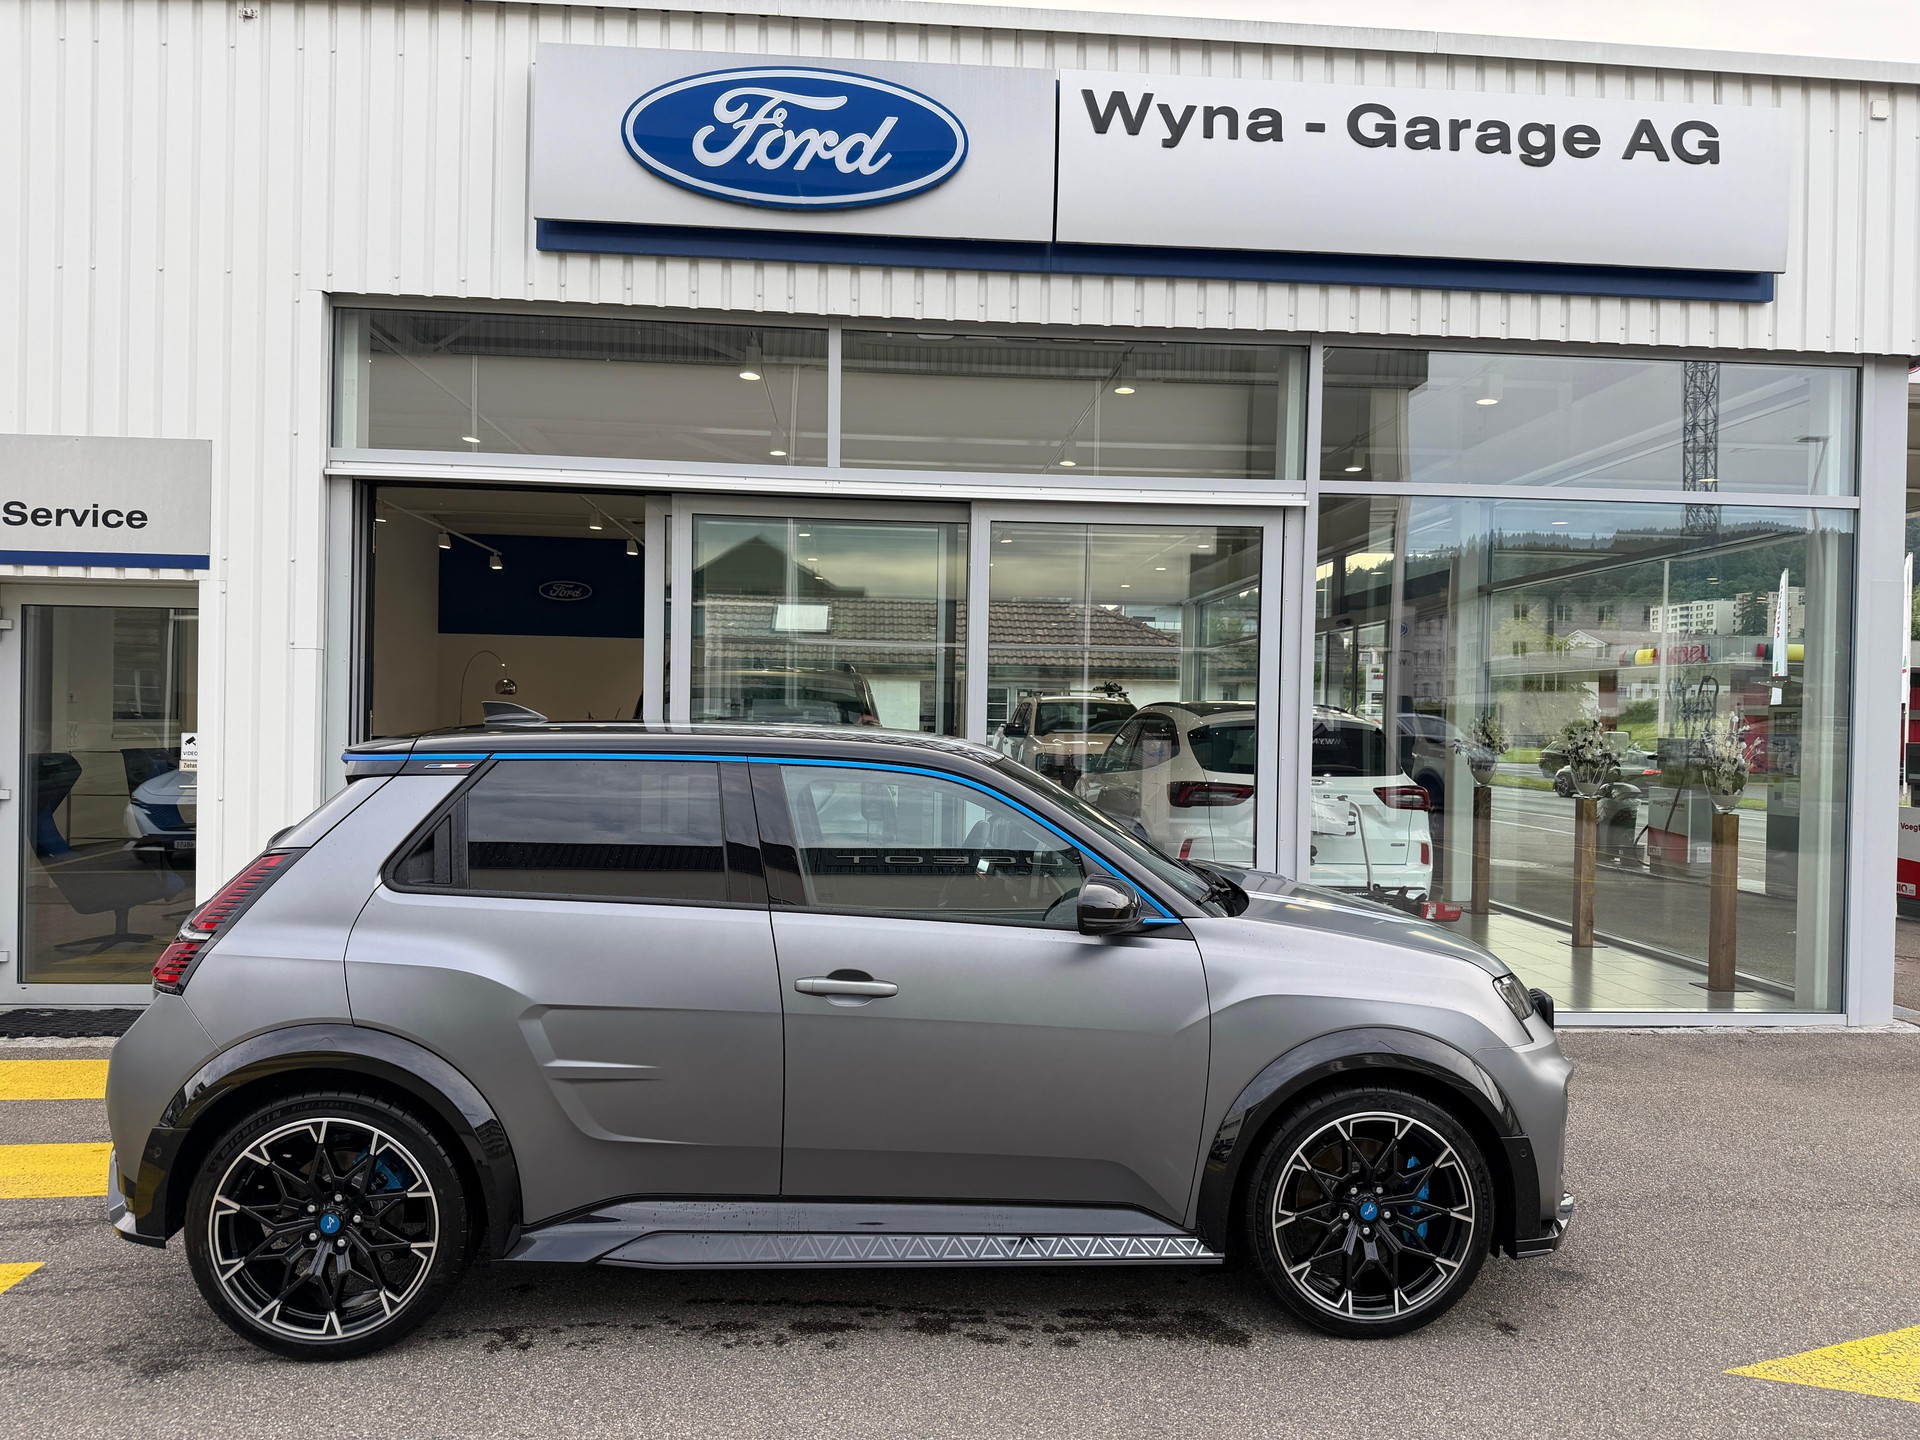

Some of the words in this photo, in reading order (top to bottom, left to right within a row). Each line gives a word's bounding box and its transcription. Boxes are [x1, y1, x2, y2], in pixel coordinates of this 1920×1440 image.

[692, 86, 899, 176] Ford
[1081, 88, 1284, 149] Wyna
[1346, 102, 1602, 167] Garage
[1622, 118, 1721, 165] AG
[2, 500, 148, 529] Service
[549, 583, 582, 597] Ford
